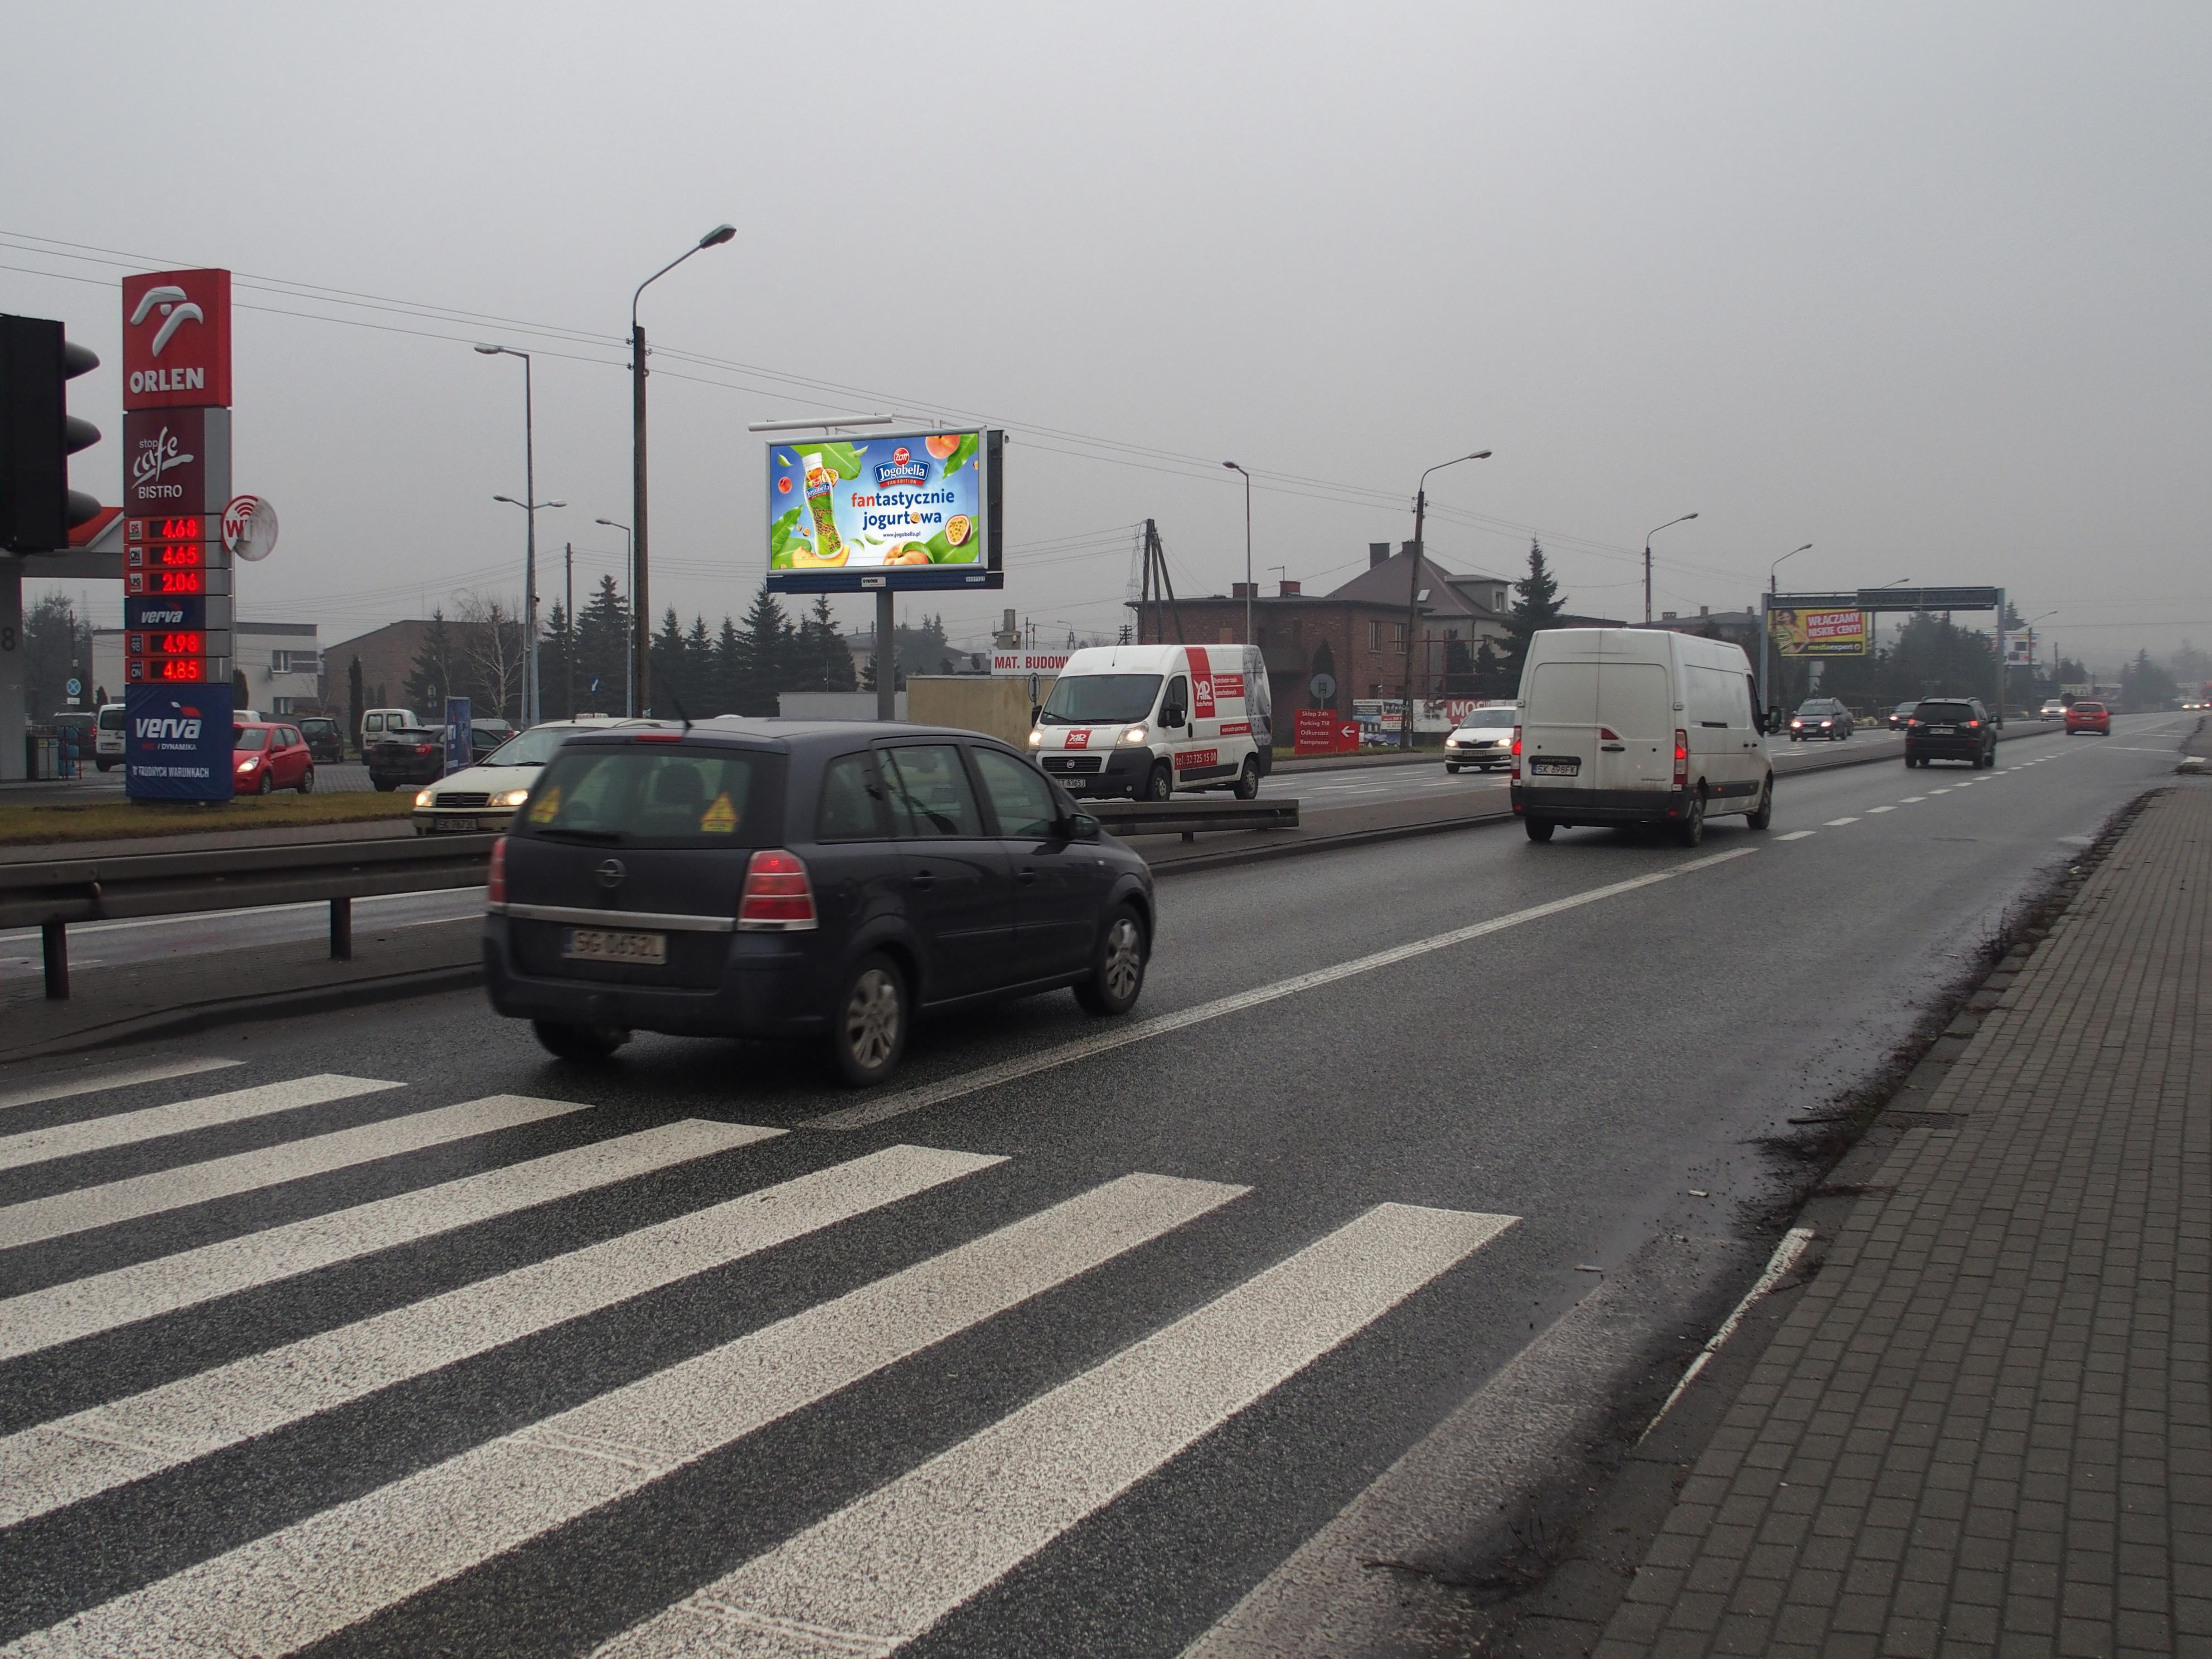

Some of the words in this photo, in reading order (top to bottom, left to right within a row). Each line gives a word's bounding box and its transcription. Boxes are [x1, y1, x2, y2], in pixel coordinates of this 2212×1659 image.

[130, 367, 204, 394] ORLEN
[139, 439, 158, 449] stop
[133, 426, 178, 482] cafe
[895, 453, 909, 462] Zott
[879, 464, 925, 481] Jogobella
[139, 484, 183, 499] BISTRO
[807, 484, 830, 498] Jogobella
[851, 488, 955, 510] fantastycznie
[162, 519, 197, 538] 4.68
[162, 546, 198, 564] 4.65
[162, 572, 198, 591] 2.06
[141, 610, 184, 623] verva
[1807, 612, 1860, 626] WŁĄCZAMY
[1, 627, 16, 651] 8
[1808, 626, 1835, 637] NISKIE
[1837, 624, 1861, 634] CENY!
[131, 642, 140, 652] 98
[163, 634, 198, 652] 4.98
[131, 668, 141, 677] ON
[163, 660, 198, 678] 4.85
[995, 656, 1020, 669] MAT.
[136, 718, 202, 739] verva
[1176, 755, 1185, 765] tel.
[1186, 755, 1192, 764] 32
[1194, 754, 1202, 763] 325
[1204, 753, 1210, 762] 15
[1211, 752, 1216, 761] 00
[168, 767, 210, 778] WARUNKACH
